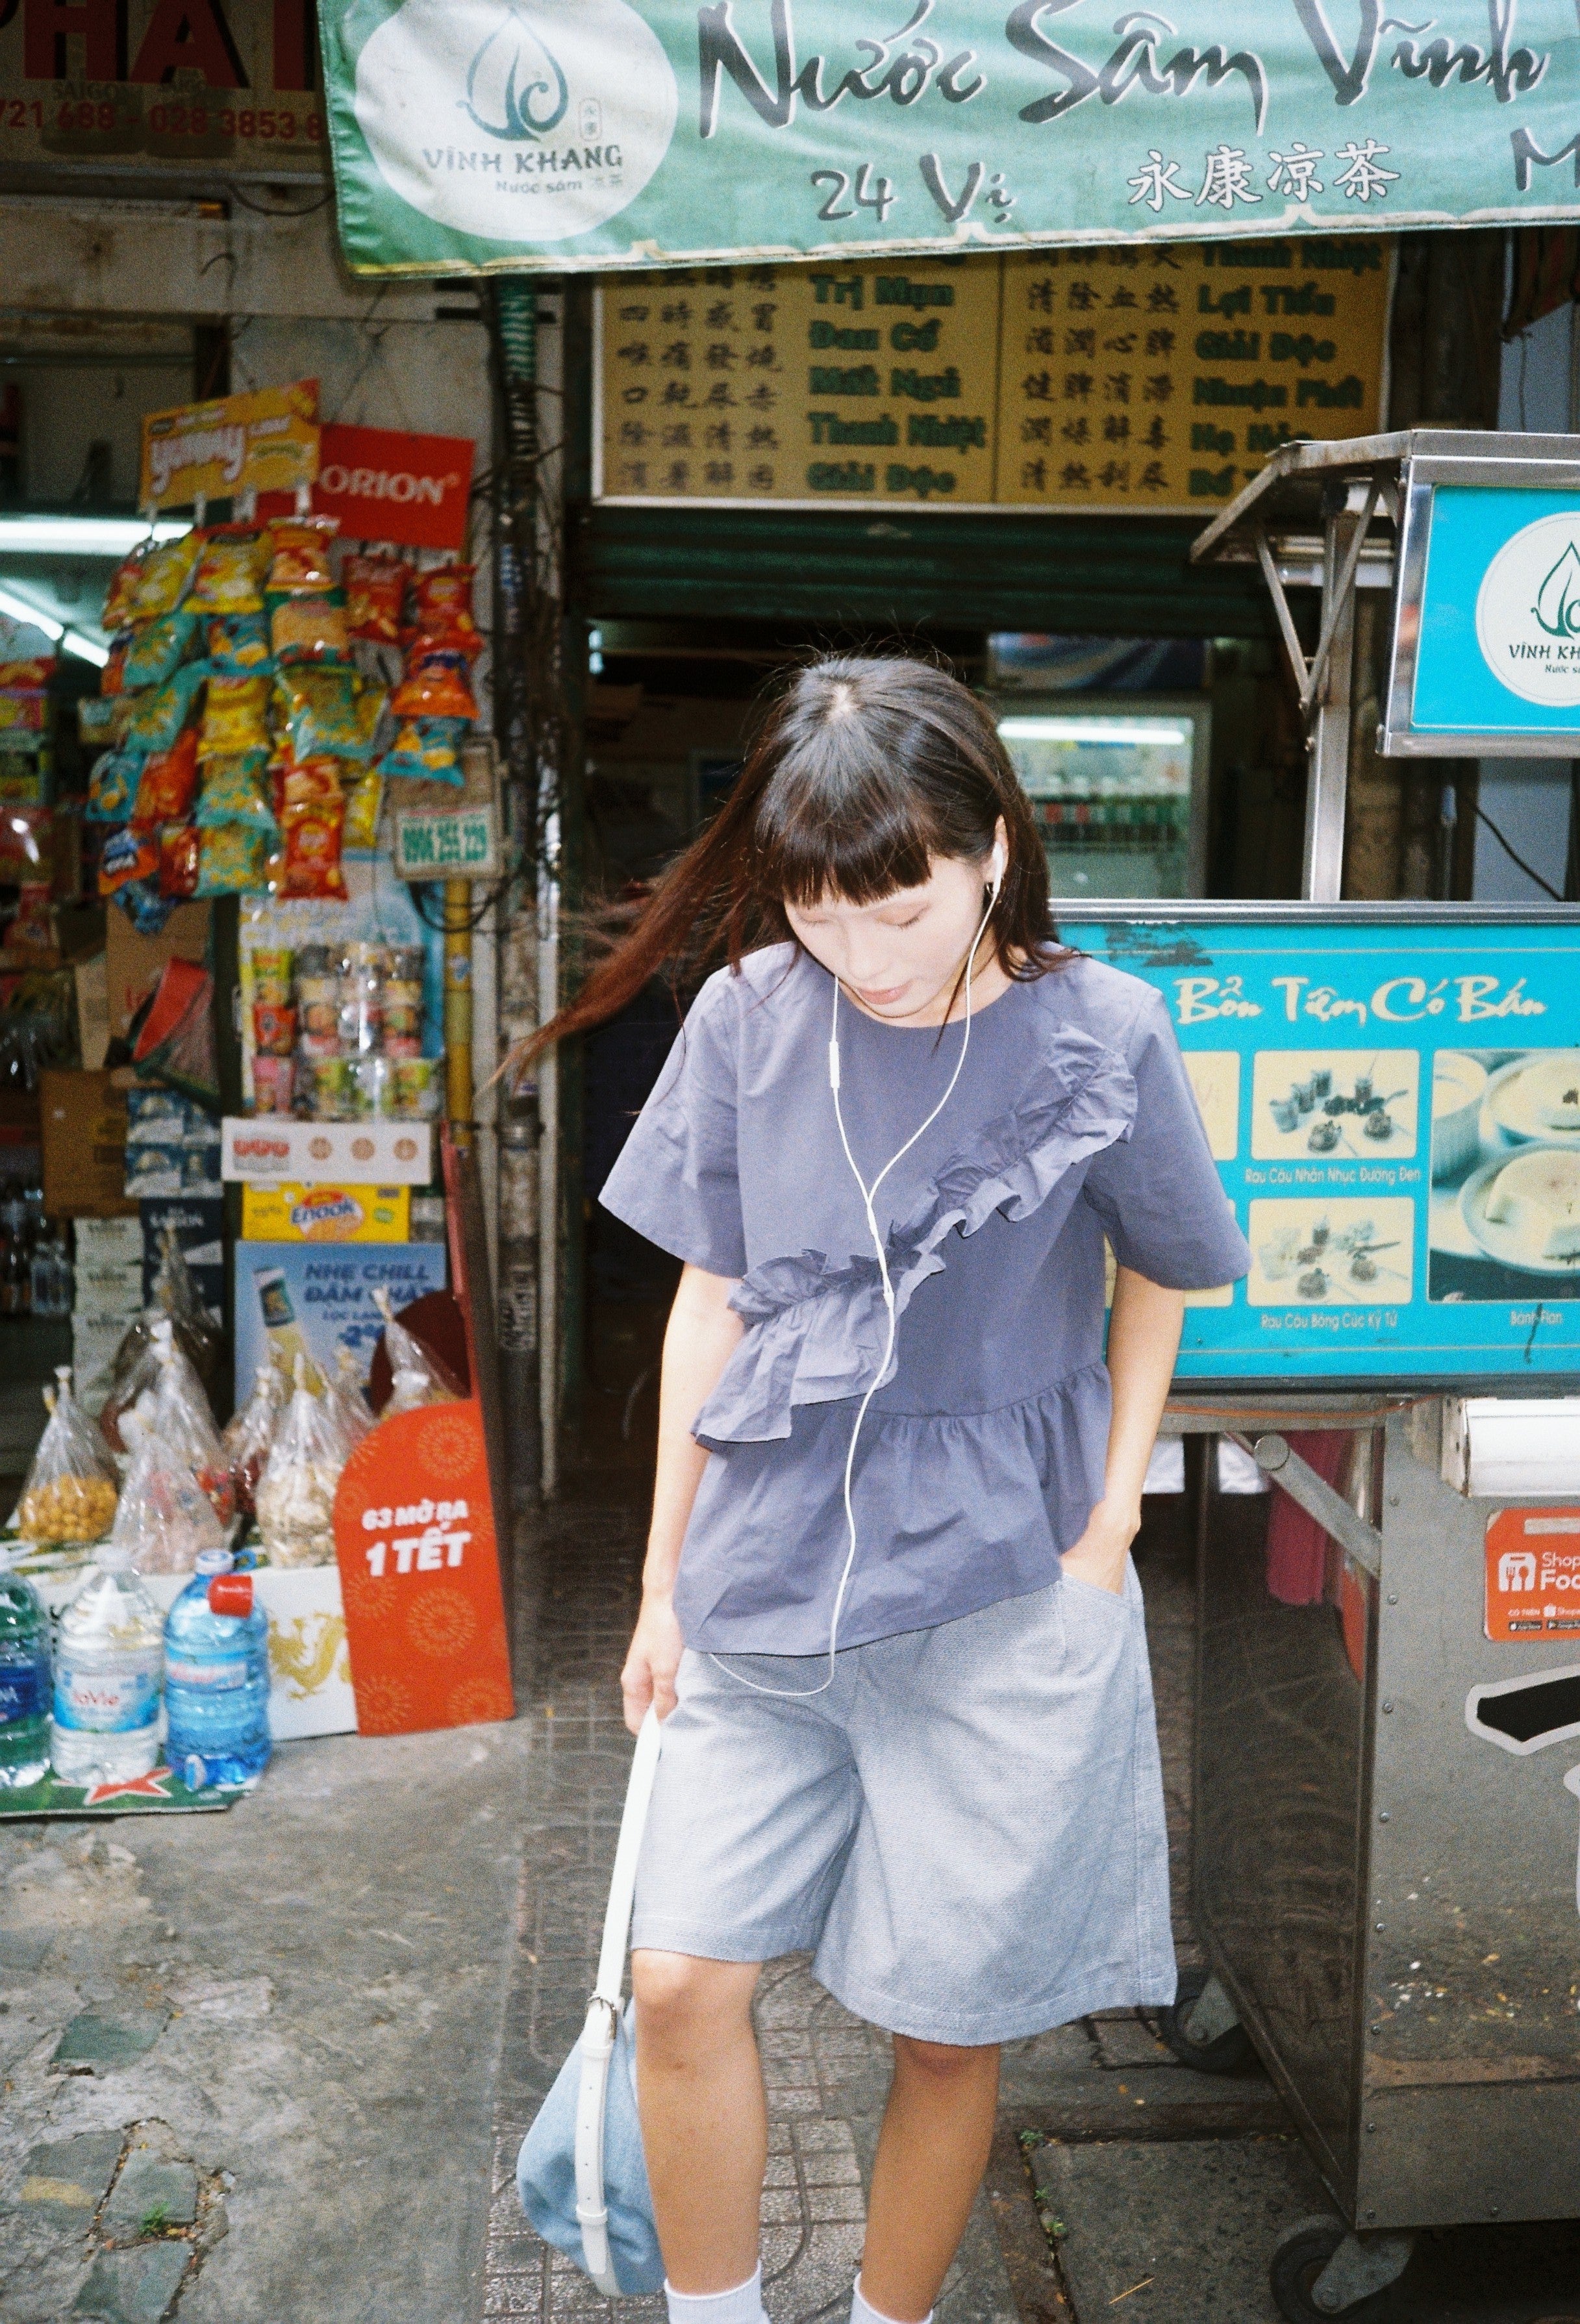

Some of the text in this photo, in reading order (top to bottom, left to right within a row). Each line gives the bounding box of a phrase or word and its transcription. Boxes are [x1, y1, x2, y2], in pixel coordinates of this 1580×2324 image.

[698, 0, 1550, 138] Nước Sâm Vĩnh
[150, 105, 208, 135] 028
[219, 108, 297, 140] 3853
[515, 144, 623, 174] KHANG
[1127, 139, 1401, 212] 永康凉茶
[810, 153, 1017, 224] 24 Vị
[320, 464, 446, 507] ORION
[1370, 976, 1449, 1022] Có
[1453, 975, 1548, 1024] Bán
[365, 1541, 387, 1578] 1
